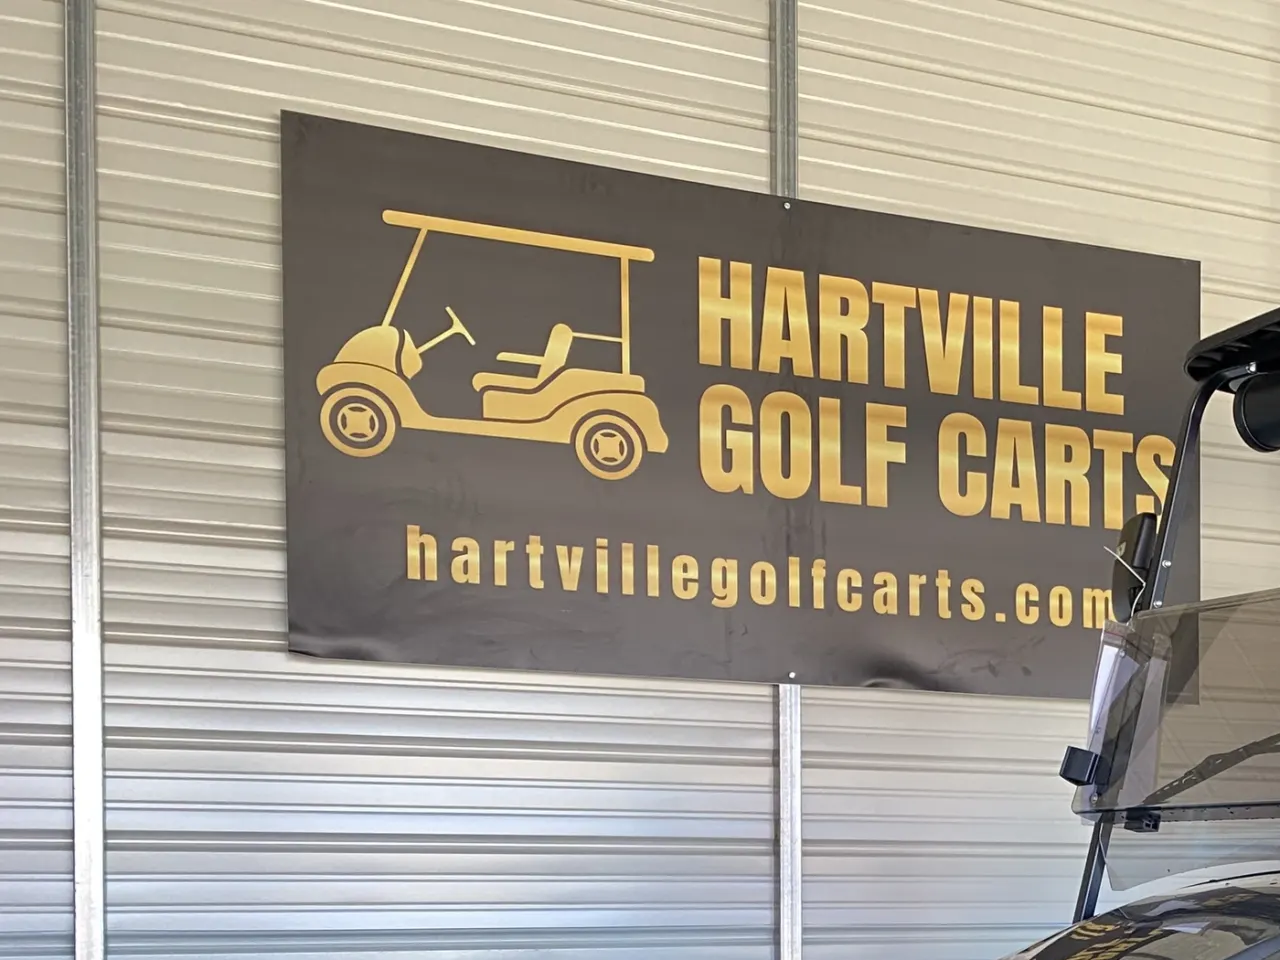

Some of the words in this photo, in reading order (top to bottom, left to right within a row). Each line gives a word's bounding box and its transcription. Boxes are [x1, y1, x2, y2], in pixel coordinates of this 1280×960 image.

[698, 256, 1124, 415] HARTVILLE
[698, 384, 908, 508] GOLF
[937, 414, 1176, 535] CARTS
[406, 525, 1116, 630] hartvillegolfcarts.com
